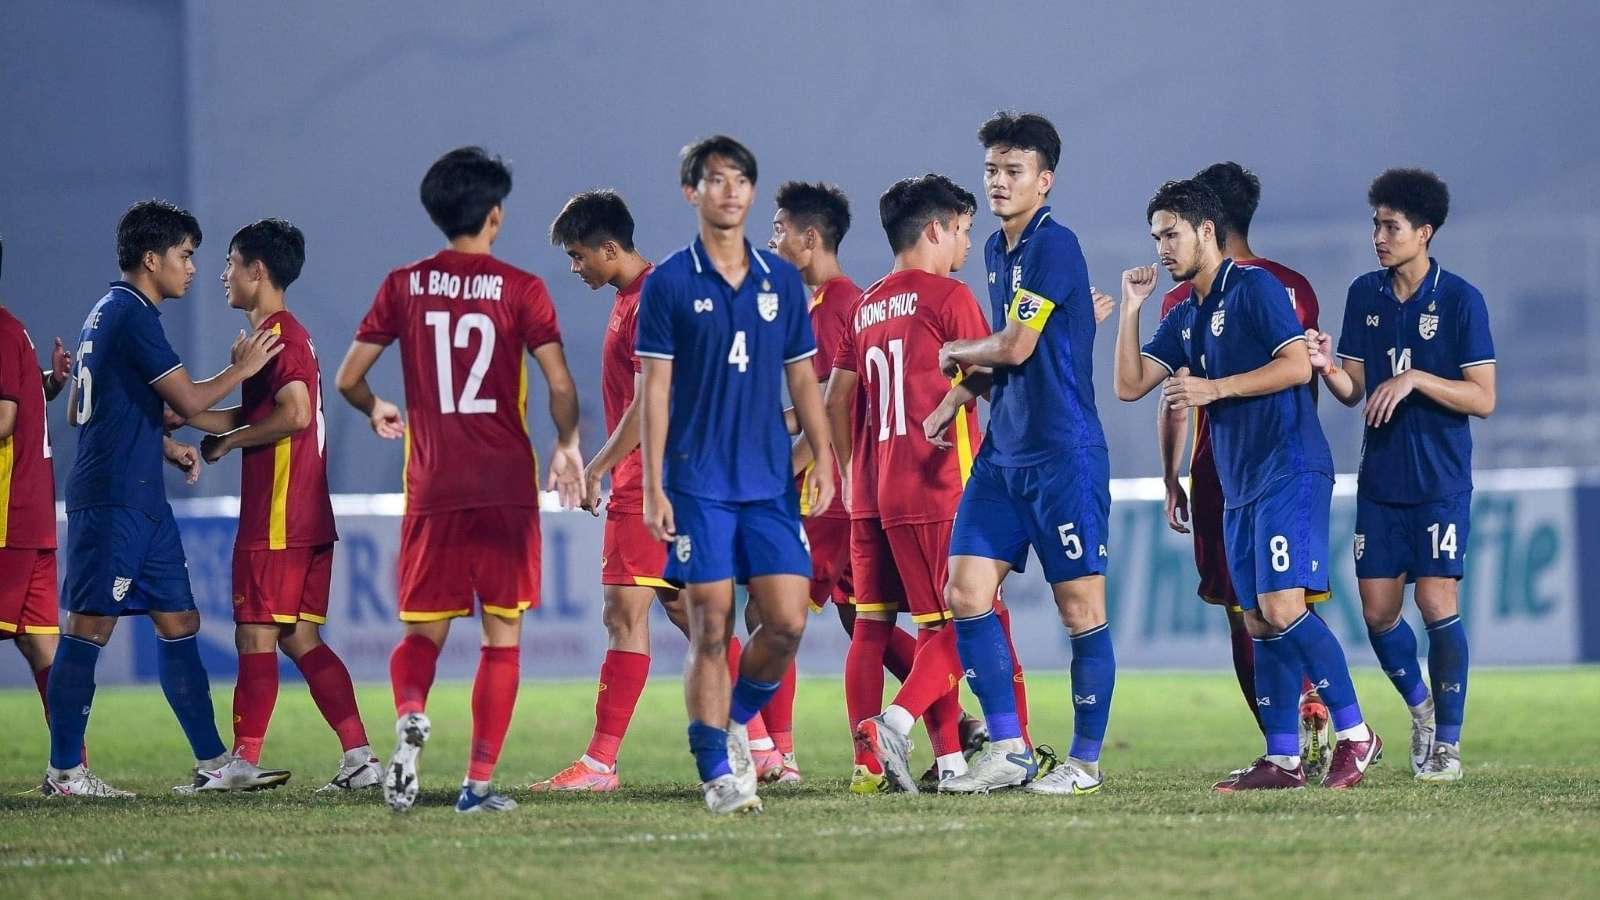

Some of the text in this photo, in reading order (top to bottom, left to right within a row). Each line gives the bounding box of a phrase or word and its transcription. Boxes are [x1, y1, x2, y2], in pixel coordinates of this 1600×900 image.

[410, 270, 503, 301] N. BAO LONG
[861, 299, 886, 329] HONG
[888, 292, 918, 320] PHUC
[425, 311, 497, 414] 12
[728, 331, 749, 373] 4
[1386, 347, 1412, 377] 14
[865, 339, 906, 442] 21
[1058, 522, 1083, 560] 5
[1270, 535, 1290, 572] 8
[1427, 523, 1458, 560] 14
